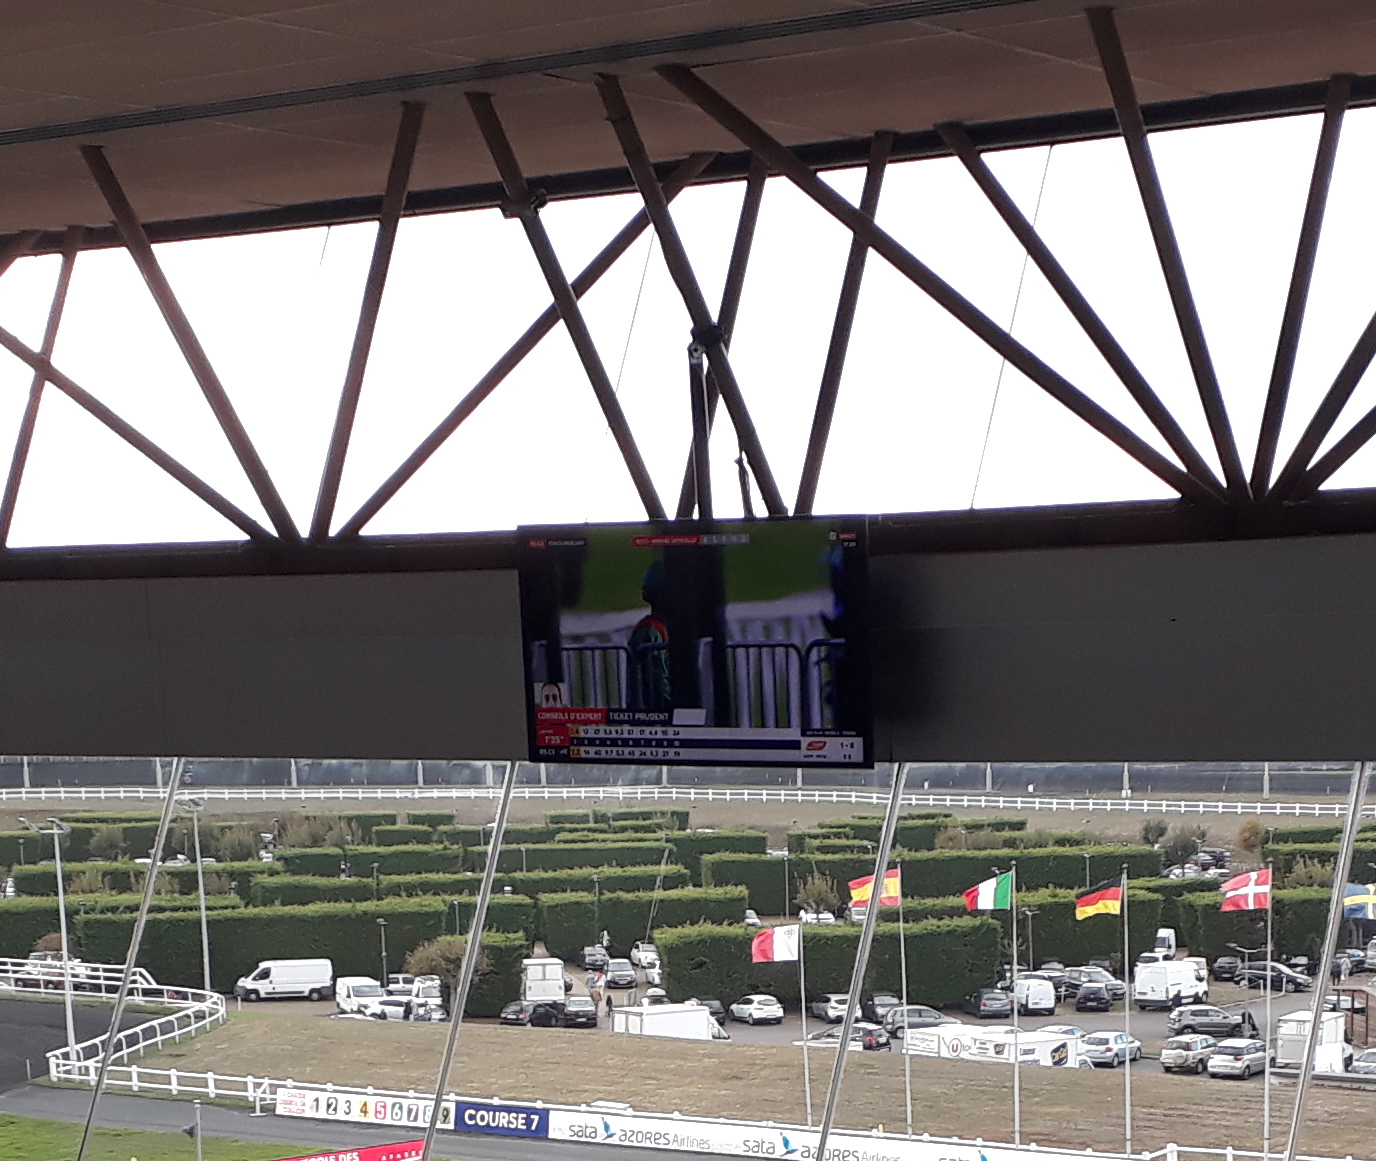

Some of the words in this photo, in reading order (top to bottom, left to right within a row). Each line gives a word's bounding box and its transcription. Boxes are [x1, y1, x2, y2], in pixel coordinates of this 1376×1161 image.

[313, 1097, 319, 1113] 1
[328, 1098, 337, 1114] 2
[344, 1100, 351, 1115] 3
[360, 1101, 369, 1117] 4
[376, 1102, 385, 1119] 5
[392, 1104, 401, 1120] 6
[409, 1105, 418, 1121] 7
[442, 1107, 450, 1124] 9
[464, 1109, 526, 1130] COURSE
[529, 1115, 540, 1131] 7
[568, 1123, 597, 1140] sata
[672, 1133, 711, 1150] Airlines
[743, 1138, 775, 1155] sata
